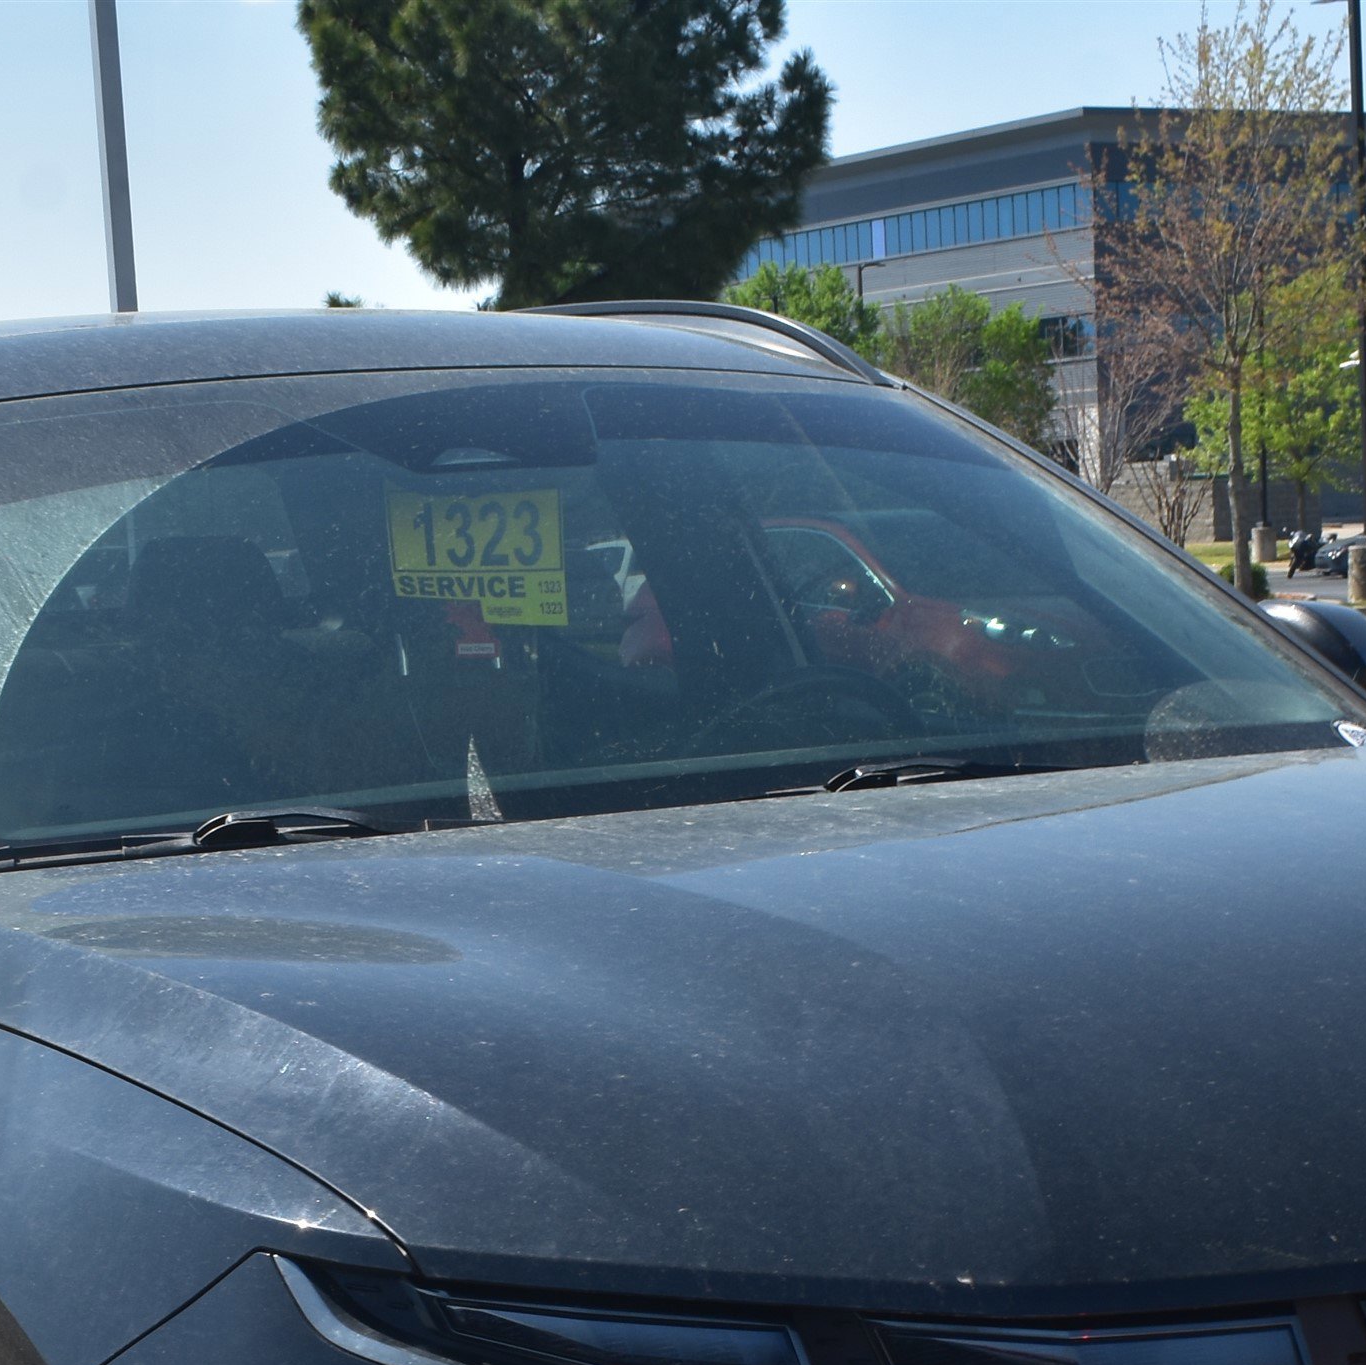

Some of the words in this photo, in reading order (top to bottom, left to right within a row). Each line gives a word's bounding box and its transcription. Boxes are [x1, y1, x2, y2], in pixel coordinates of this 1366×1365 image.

[413, 501, 543, 566] 1323
[398, 575, 526, 598] SERVICE
[538, 580, 562, 594] 1323
[539, 601, 564, 614] 1323
